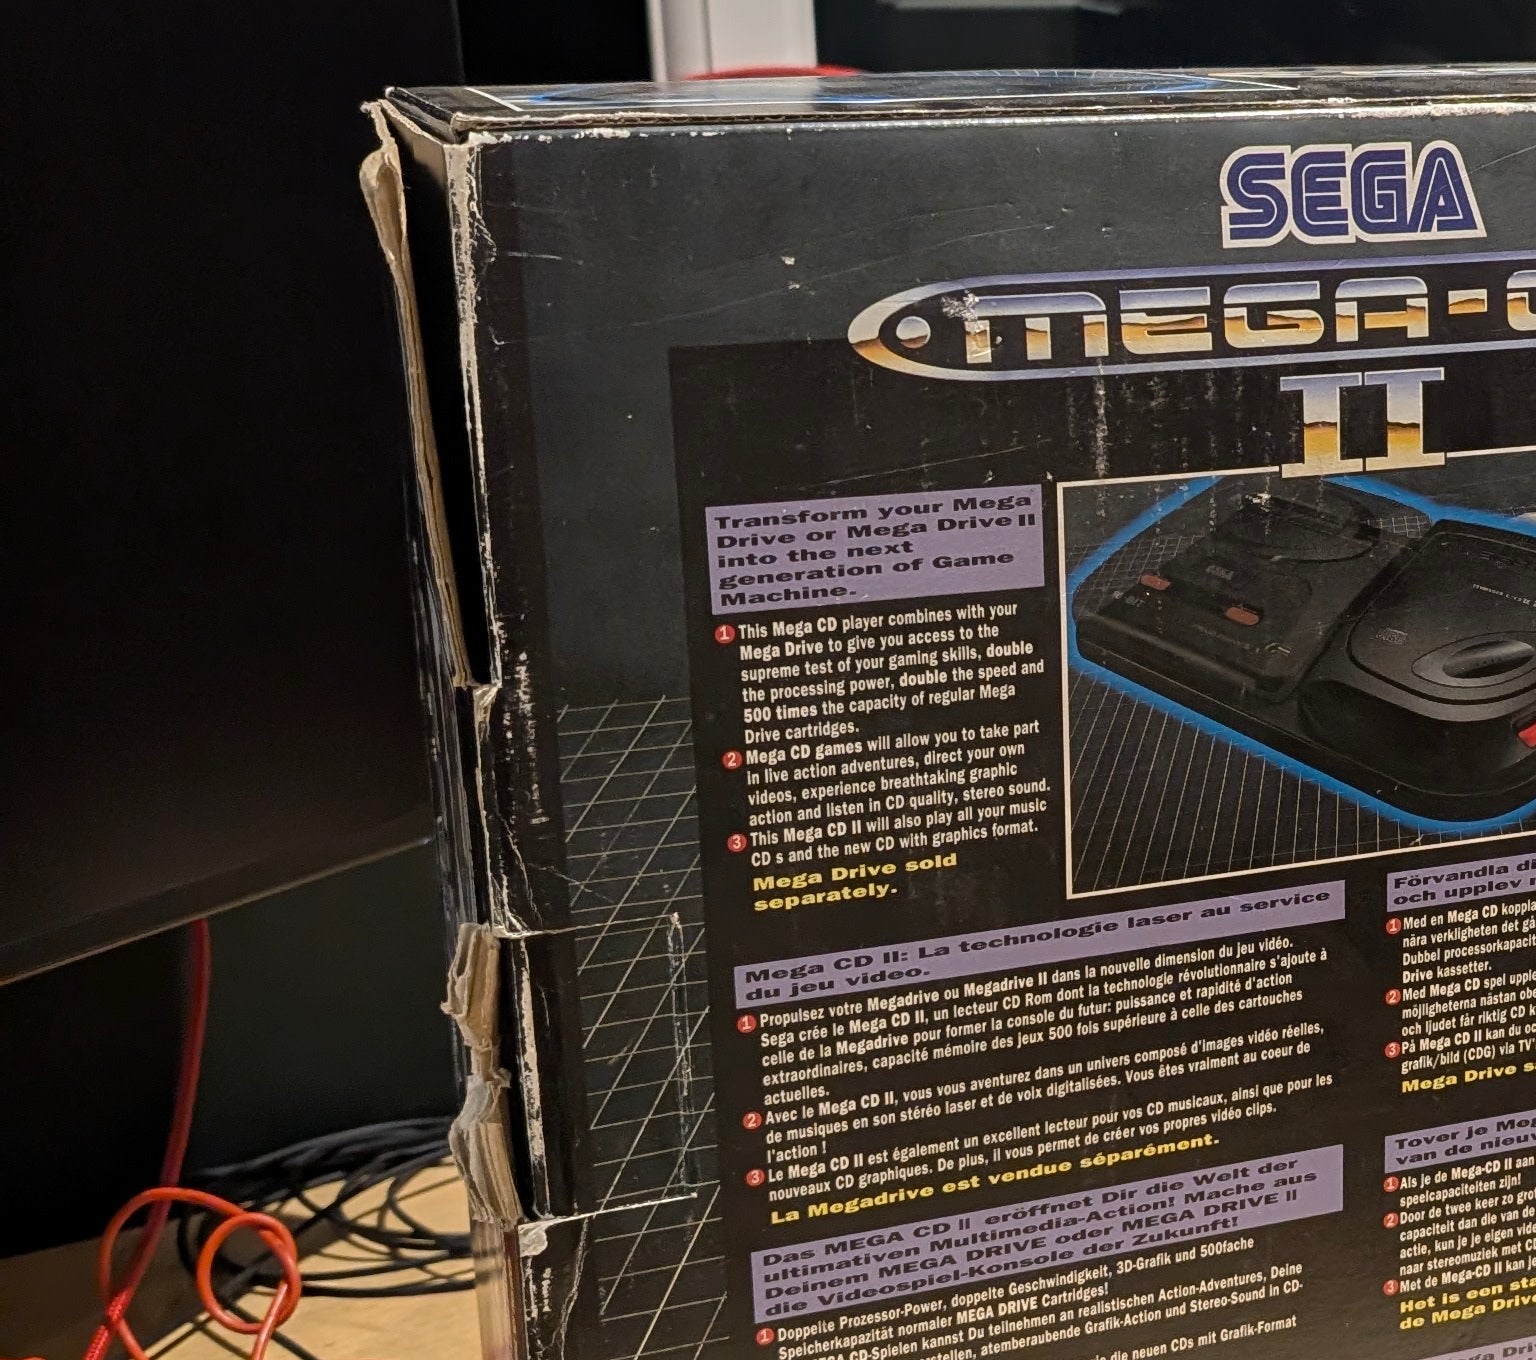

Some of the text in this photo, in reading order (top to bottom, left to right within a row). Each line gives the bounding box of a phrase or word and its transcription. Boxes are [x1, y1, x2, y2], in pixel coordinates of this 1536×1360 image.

[1219, 140, 1485, 247] SEGA
[1280, 366, 1445, 478] II
[713, 495, 1031, 529] Transform your Mega
[716, 512, 1035, 549] Drive or Mega Drive II
[717, 540, 914, 568] into the next
[718, 552, 1014, 590] generation of Game
[720, 585, 856, 606] Machine.
[737, 603, 1017, 639] This Mega CD player combines with your
[739, 623, 999, 662] Mega Drive to give you access to the
[752, 852, 957, 891] Mega Drive sold
[1393, 864, 1509, 889] Förvandla
[754, 882, 897, 911] separately.
[1392, 889, 1436, 905] och
[1443, 878, 1521, 898] upplev
[745, 891, 1330, 983] Mega CD II: La technologie laser au service
[745, 967, 930, 1001] du jeu video.
[1394, 1130, 1460, 1150] Tover
[1466, 1125, 1488, 1140] je
[1395, 1150, 1437, 1165] van
[1443, 1143, 1472, 1157] de
[770, 1133, 1219, 1224] La Megadrive est vendue séparément.
[762, 1159, 1298, 1266] Das MEGA CD II eröffnet Dir die Welt der
[763, 1171, 1317, 1283] ultimativen Multimedia-Action! Mache aus
